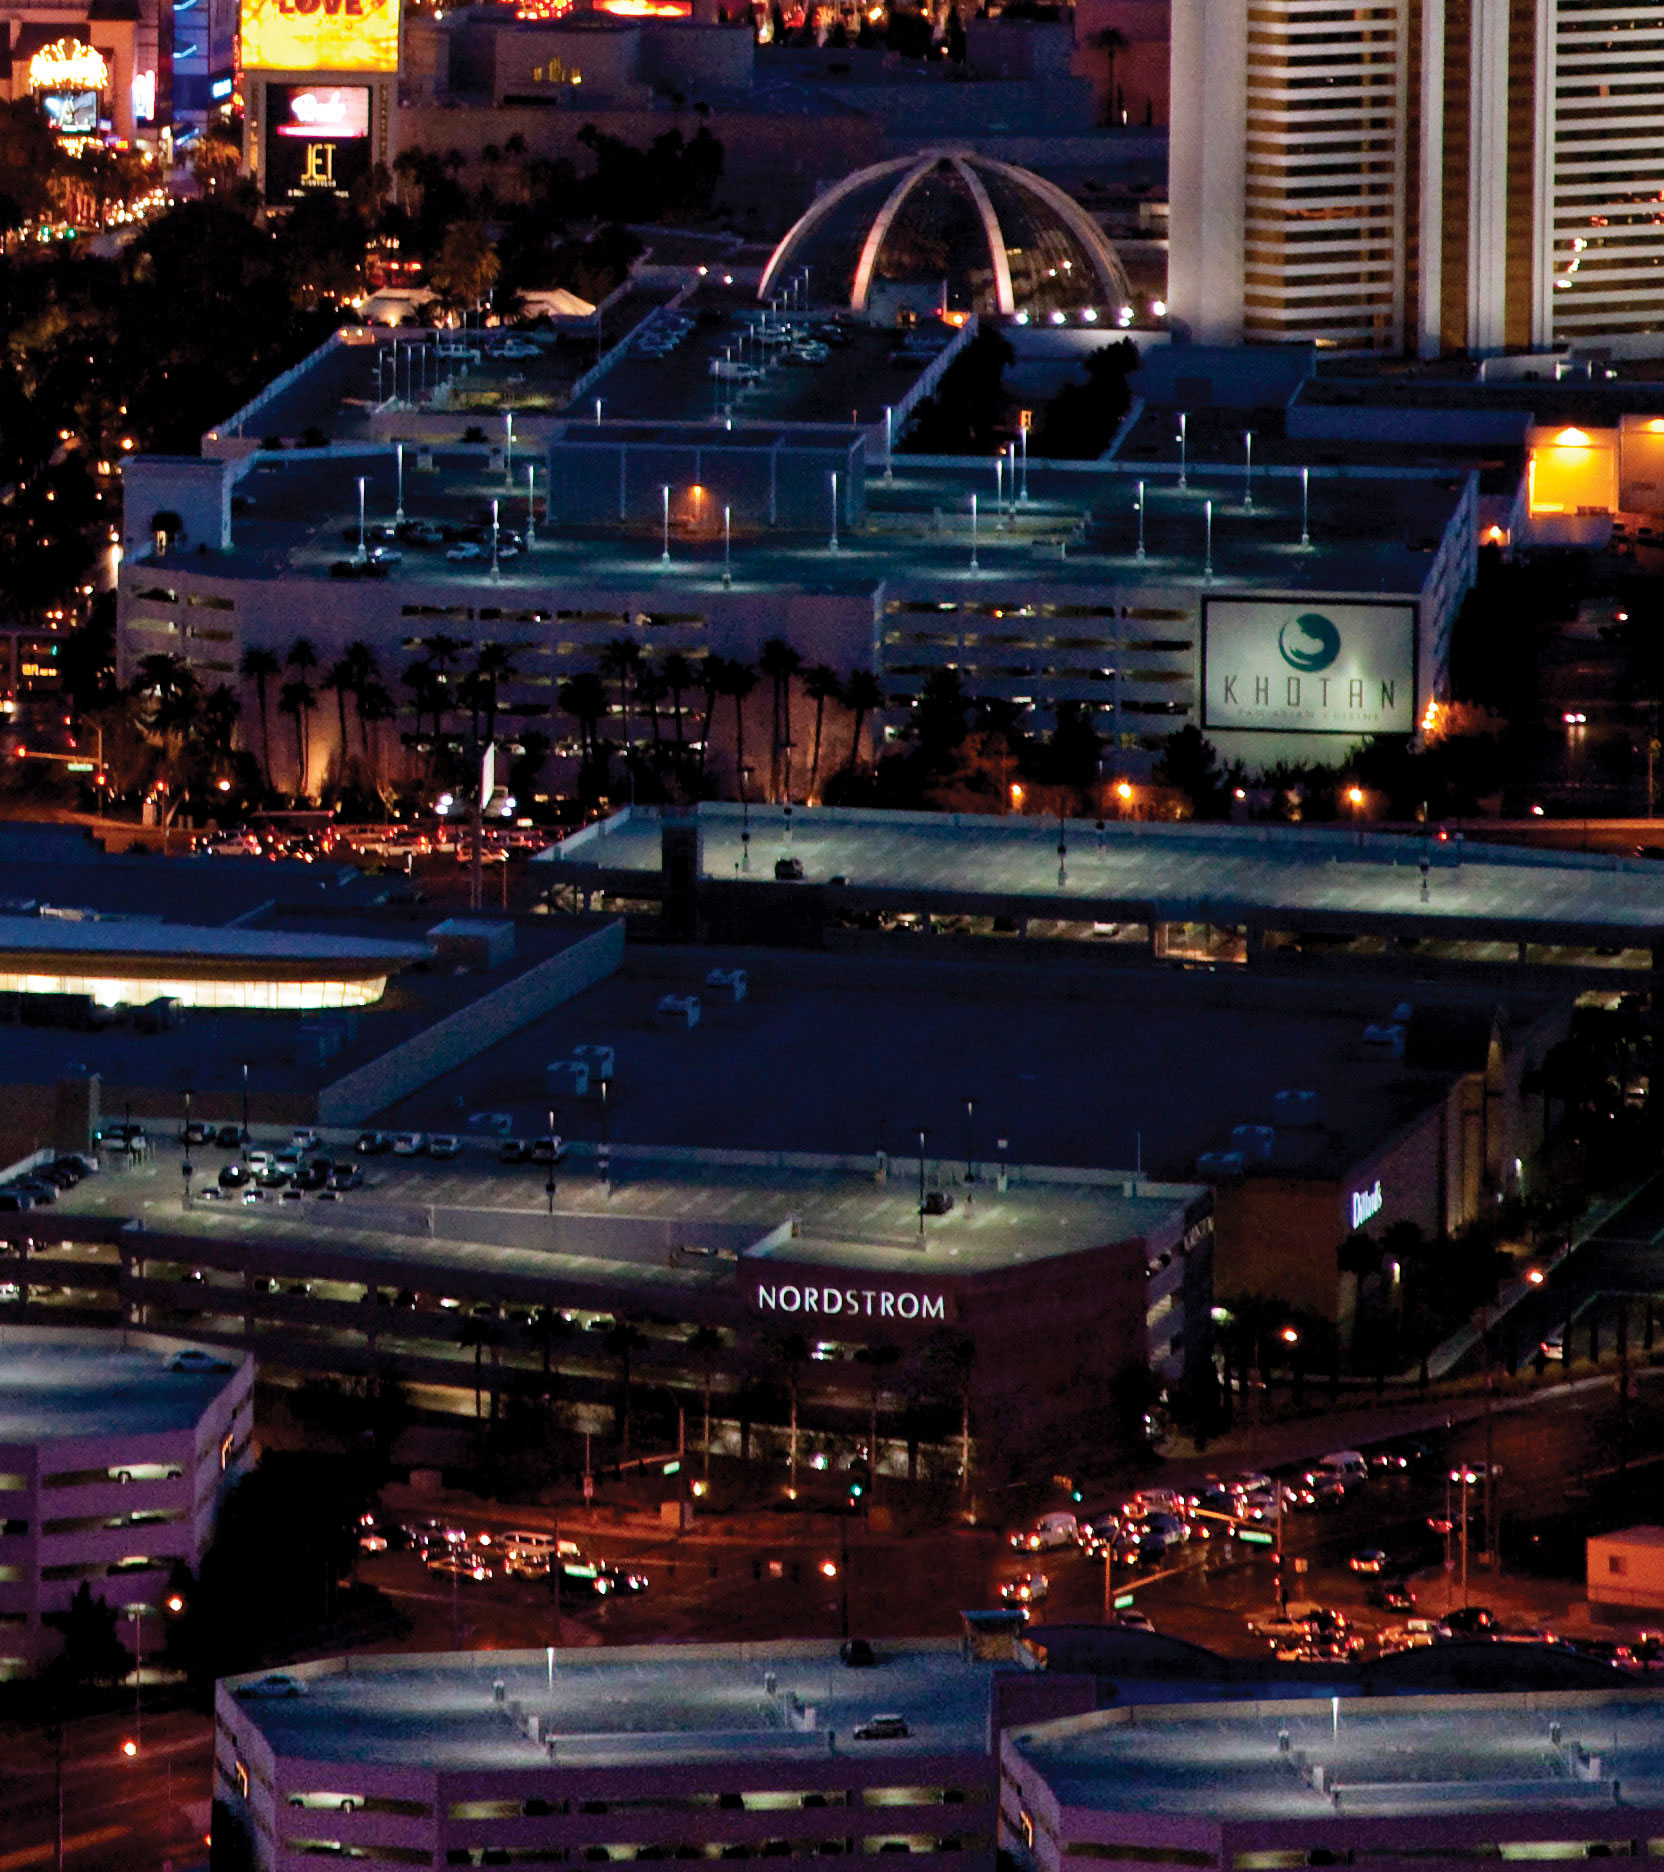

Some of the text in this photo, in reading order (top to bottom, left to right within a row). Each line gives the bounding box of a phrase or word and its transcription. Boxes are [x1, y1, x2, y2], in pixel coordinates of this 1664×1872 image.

[300, 143, 337, 181] JET
[1224, 674, 1395, 710] KHOTAN
[758, 1284, 945, 1320] NORDSTROM
